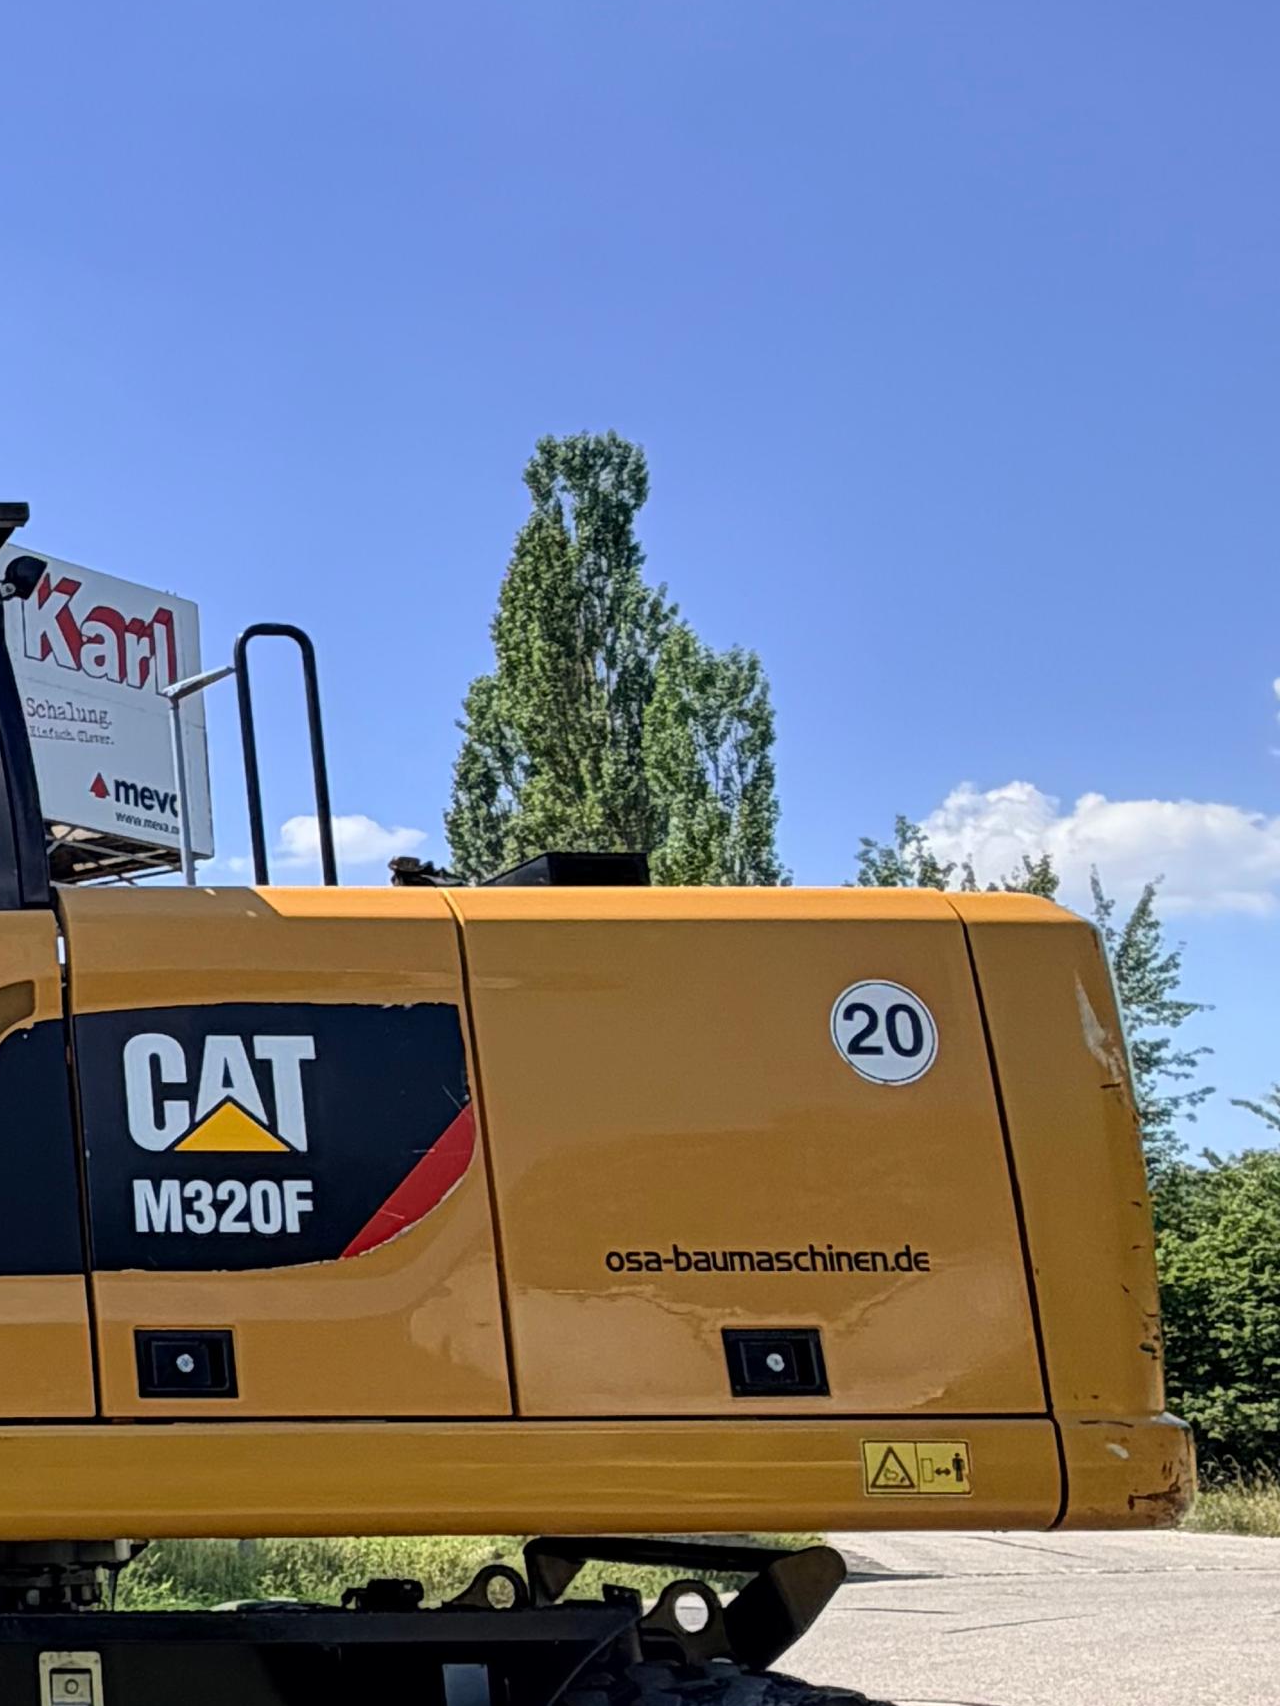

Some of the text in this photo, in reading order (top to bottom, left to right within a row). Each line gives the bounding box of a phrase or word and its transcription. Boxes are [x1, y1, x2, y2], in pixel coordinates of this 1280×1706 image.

[21, 572, 178, 698] Karl
[843, 1002, 923, 1058] 20
[123, 1032, 316, 1152] CAT
[132, 1179, 313, 1234] M320F
[605, 1244, 931, 1272] osa-baumaschinen.de
